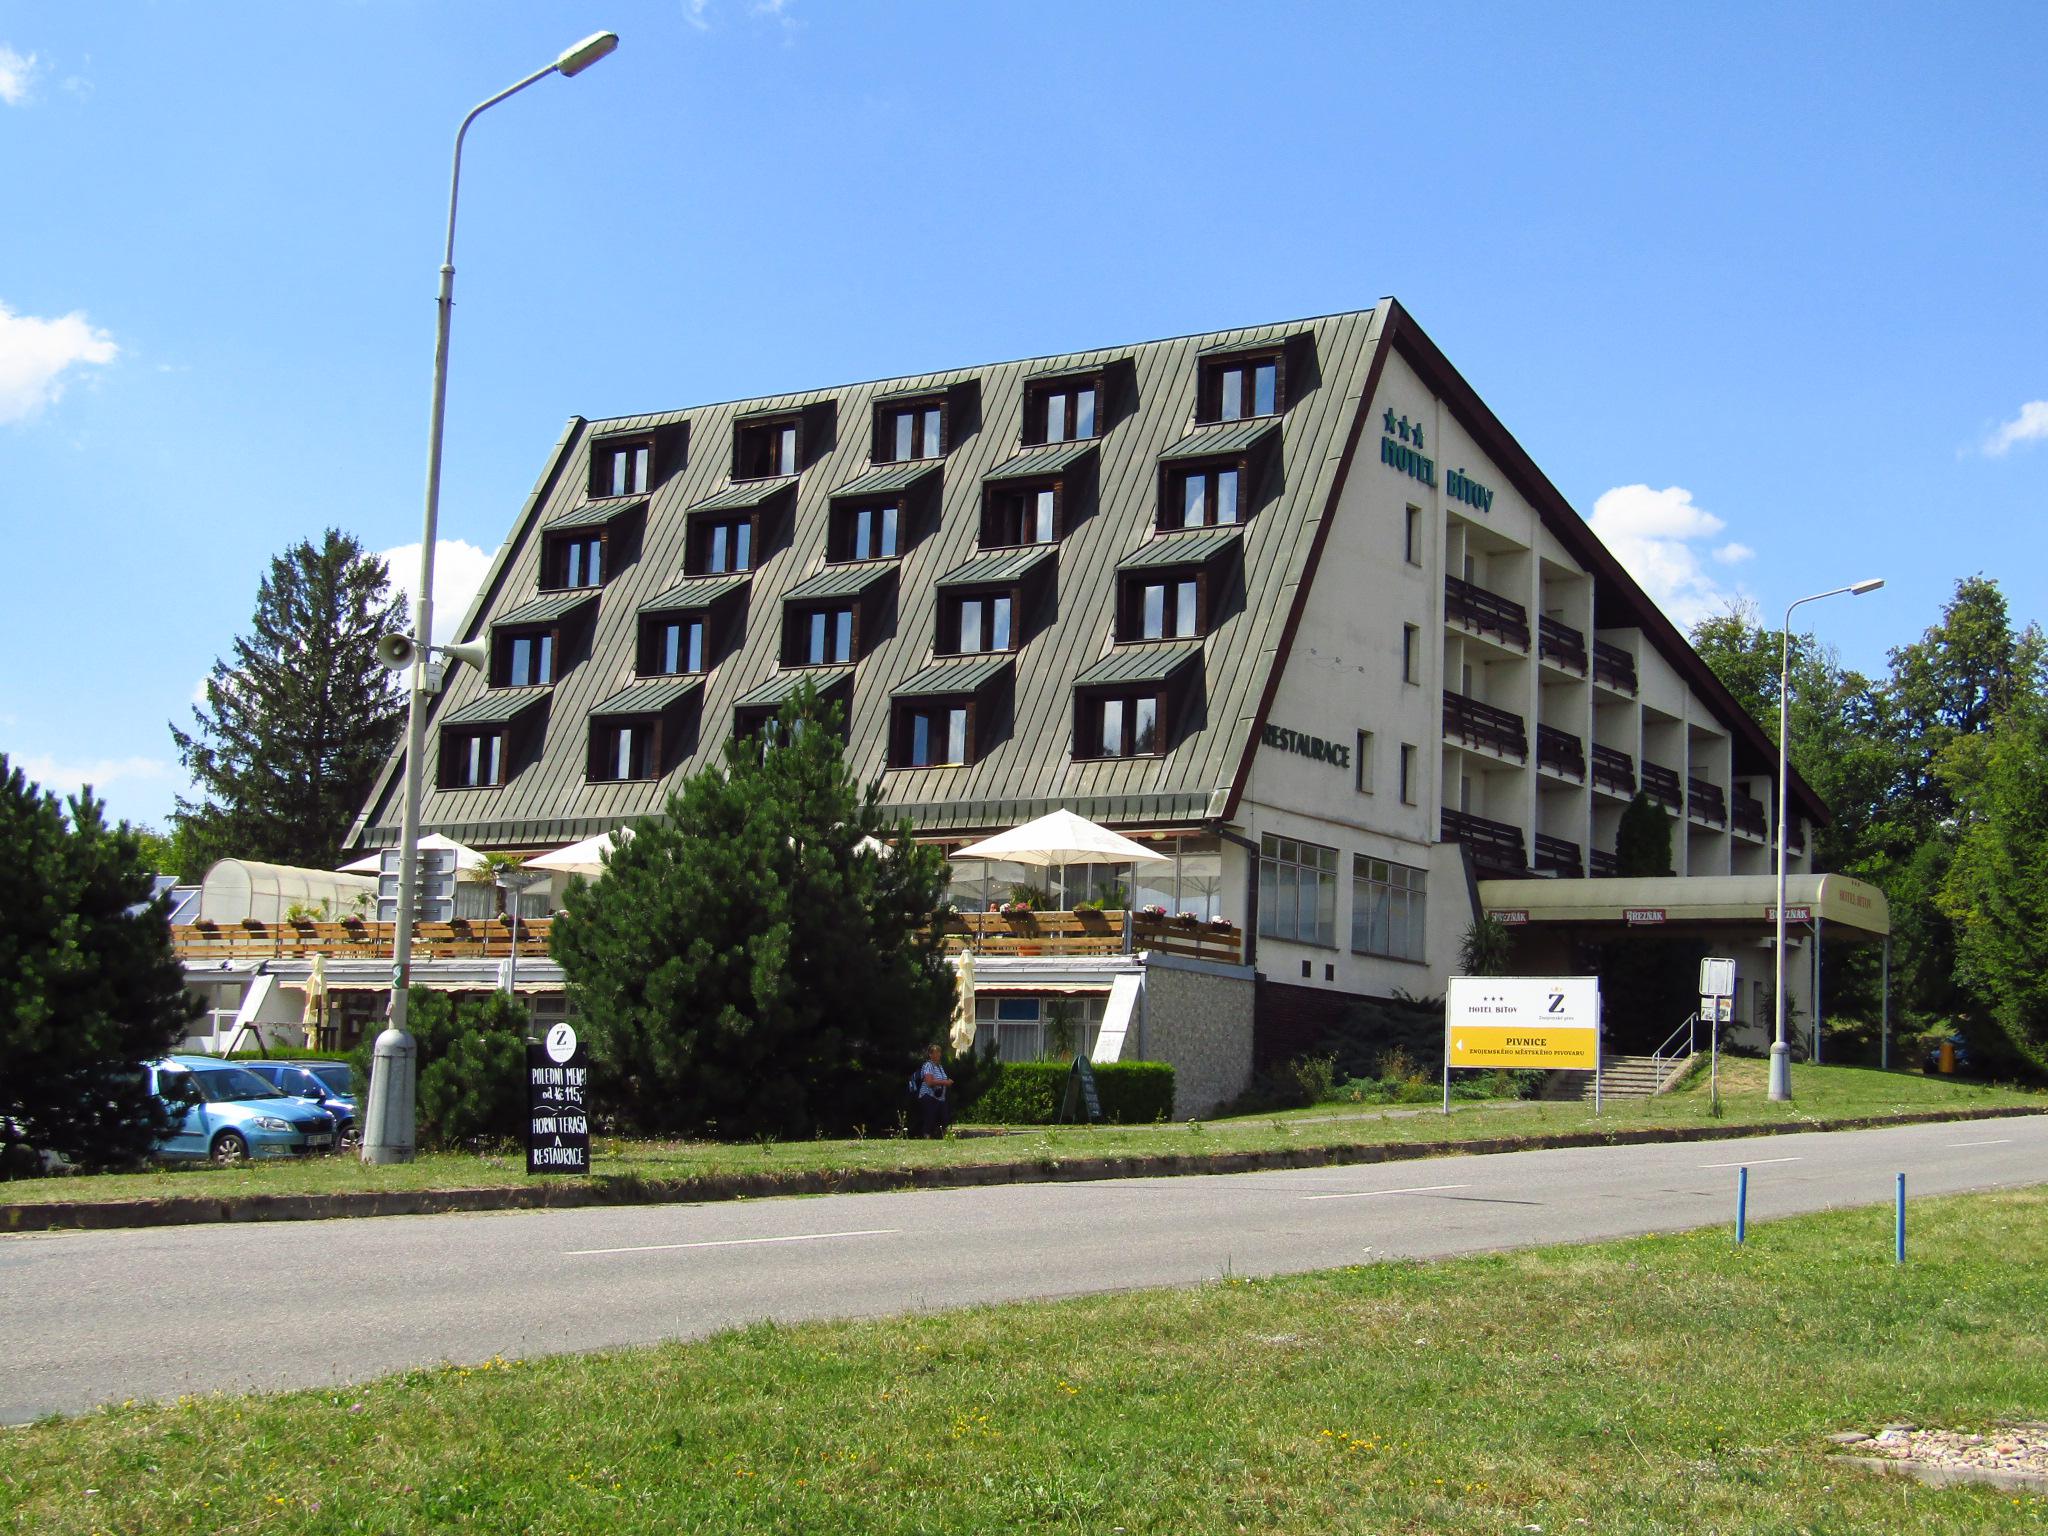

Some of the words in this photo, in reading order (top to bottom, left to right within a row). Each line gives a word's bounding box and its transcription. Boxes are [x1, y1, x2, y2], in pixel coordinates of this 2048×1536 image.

[1381, 436, 1436, 488] HOTEL
[1447, 468, 1494, 513] BÍTOV
[1262, 723, 1350, 768] RESTAURACE
[1548, 994, 1565, 1013] Z
[556, 1030, 567, 1046] Z
[1506, 1037, 1547, 1047] PIVNICE
[1515, 1048, 1553, 1056] MĚSTSKÉHO
[531, 1062, 564, 1086] POLEDNÍ
[542, 1086, 554, 1100] od
[532, 1112, 557, 1134] HORNÍ
[557, 1115, 588, 1134] TERASA
[554, 1135, 562, 1147] A
[533, 1147, 585, 1165] RESTAURACE
